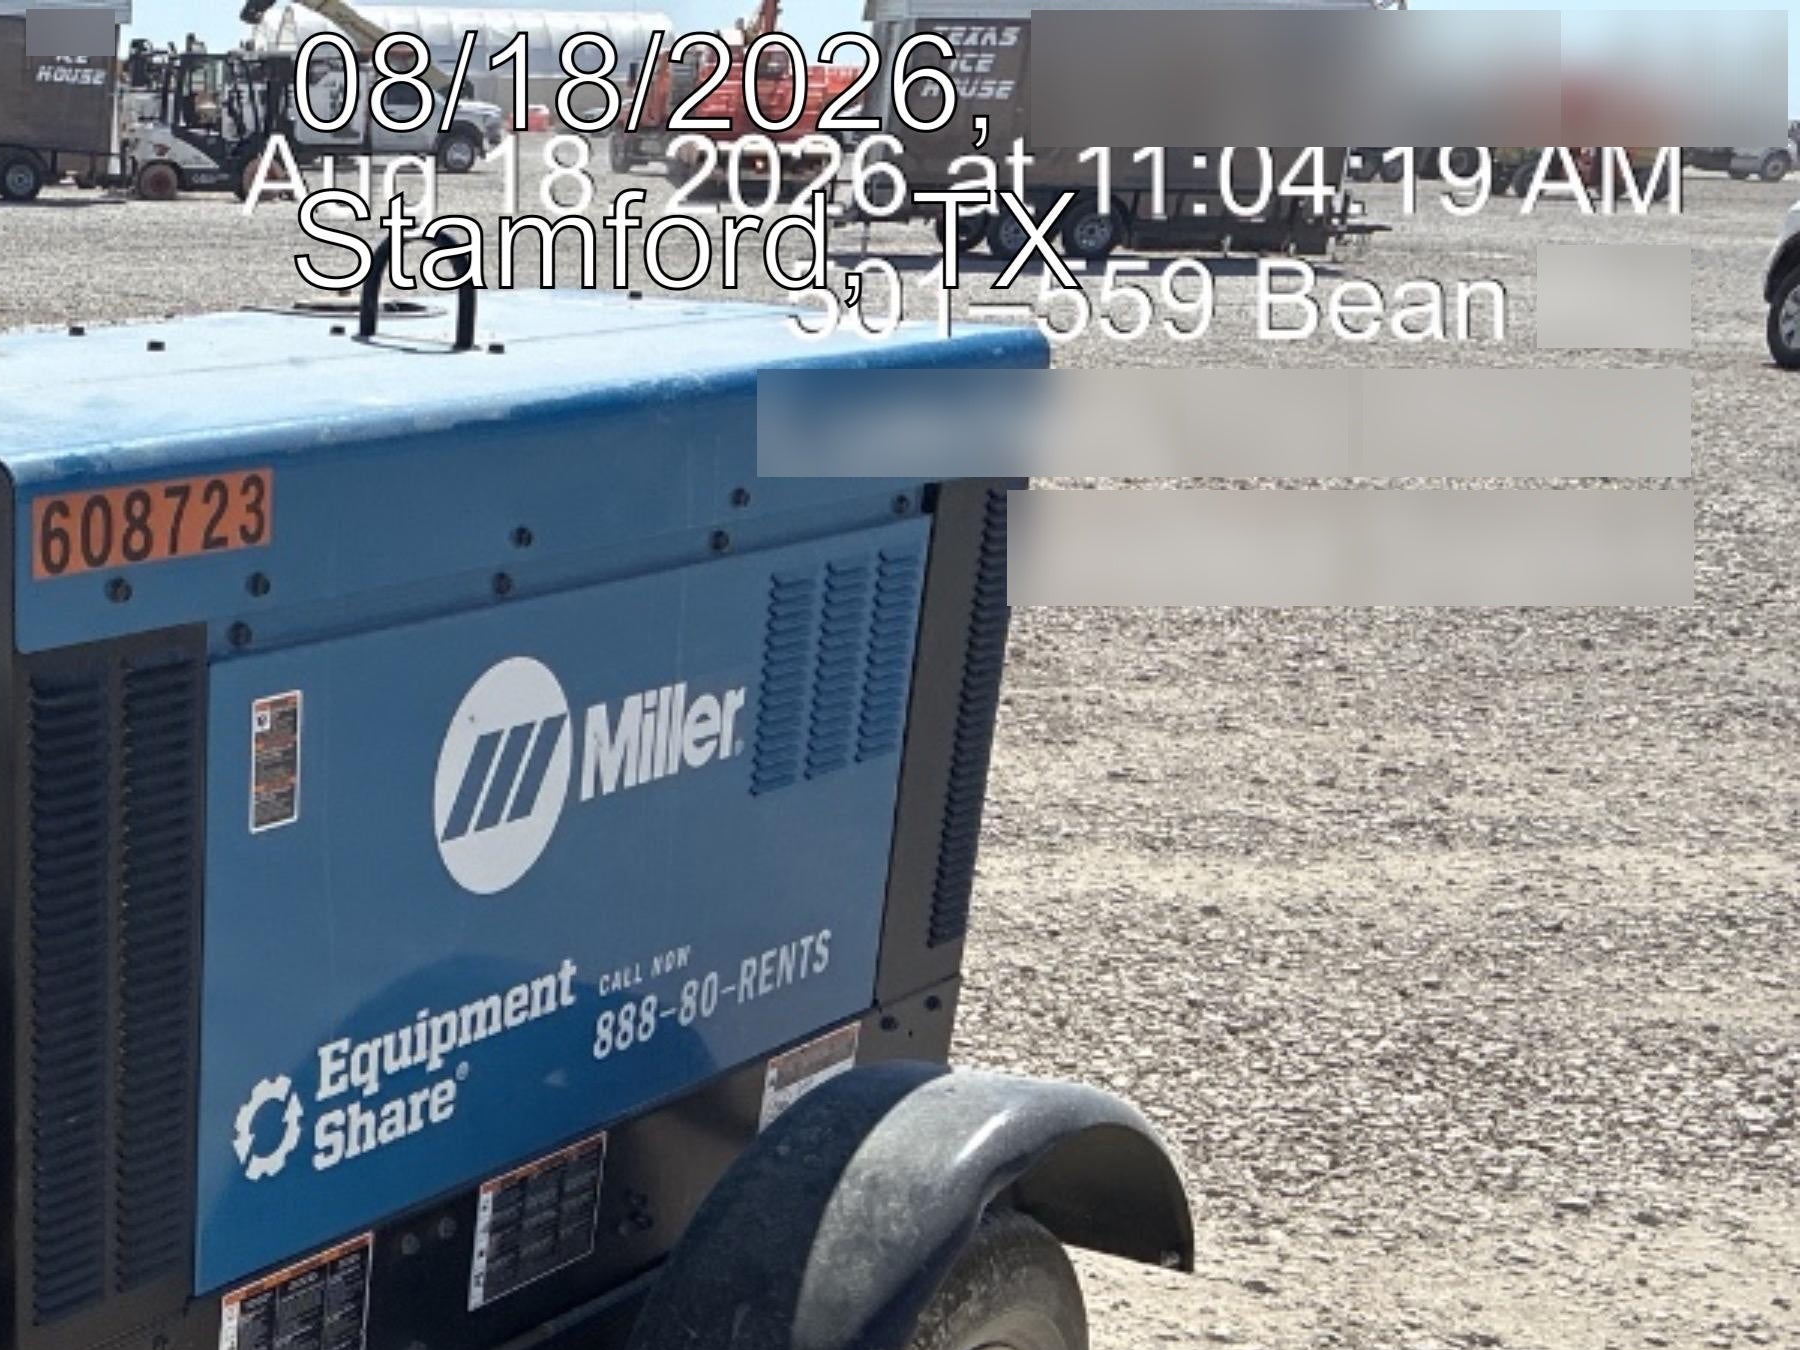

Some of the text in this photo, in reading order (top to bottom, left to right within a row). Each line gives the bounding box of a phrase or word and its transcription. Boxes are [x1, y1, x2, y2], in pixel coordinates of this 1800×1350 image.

[35, 64, 106, 86] HOUSE
[920, 78, 1016, 100] HUSE
[39, 472, 268, 576] 608723
[580, 681, 747, 802] Miller
[600, 944, 692, 998] CALL NOW
[315, 958, 577, 1102] Equipment
